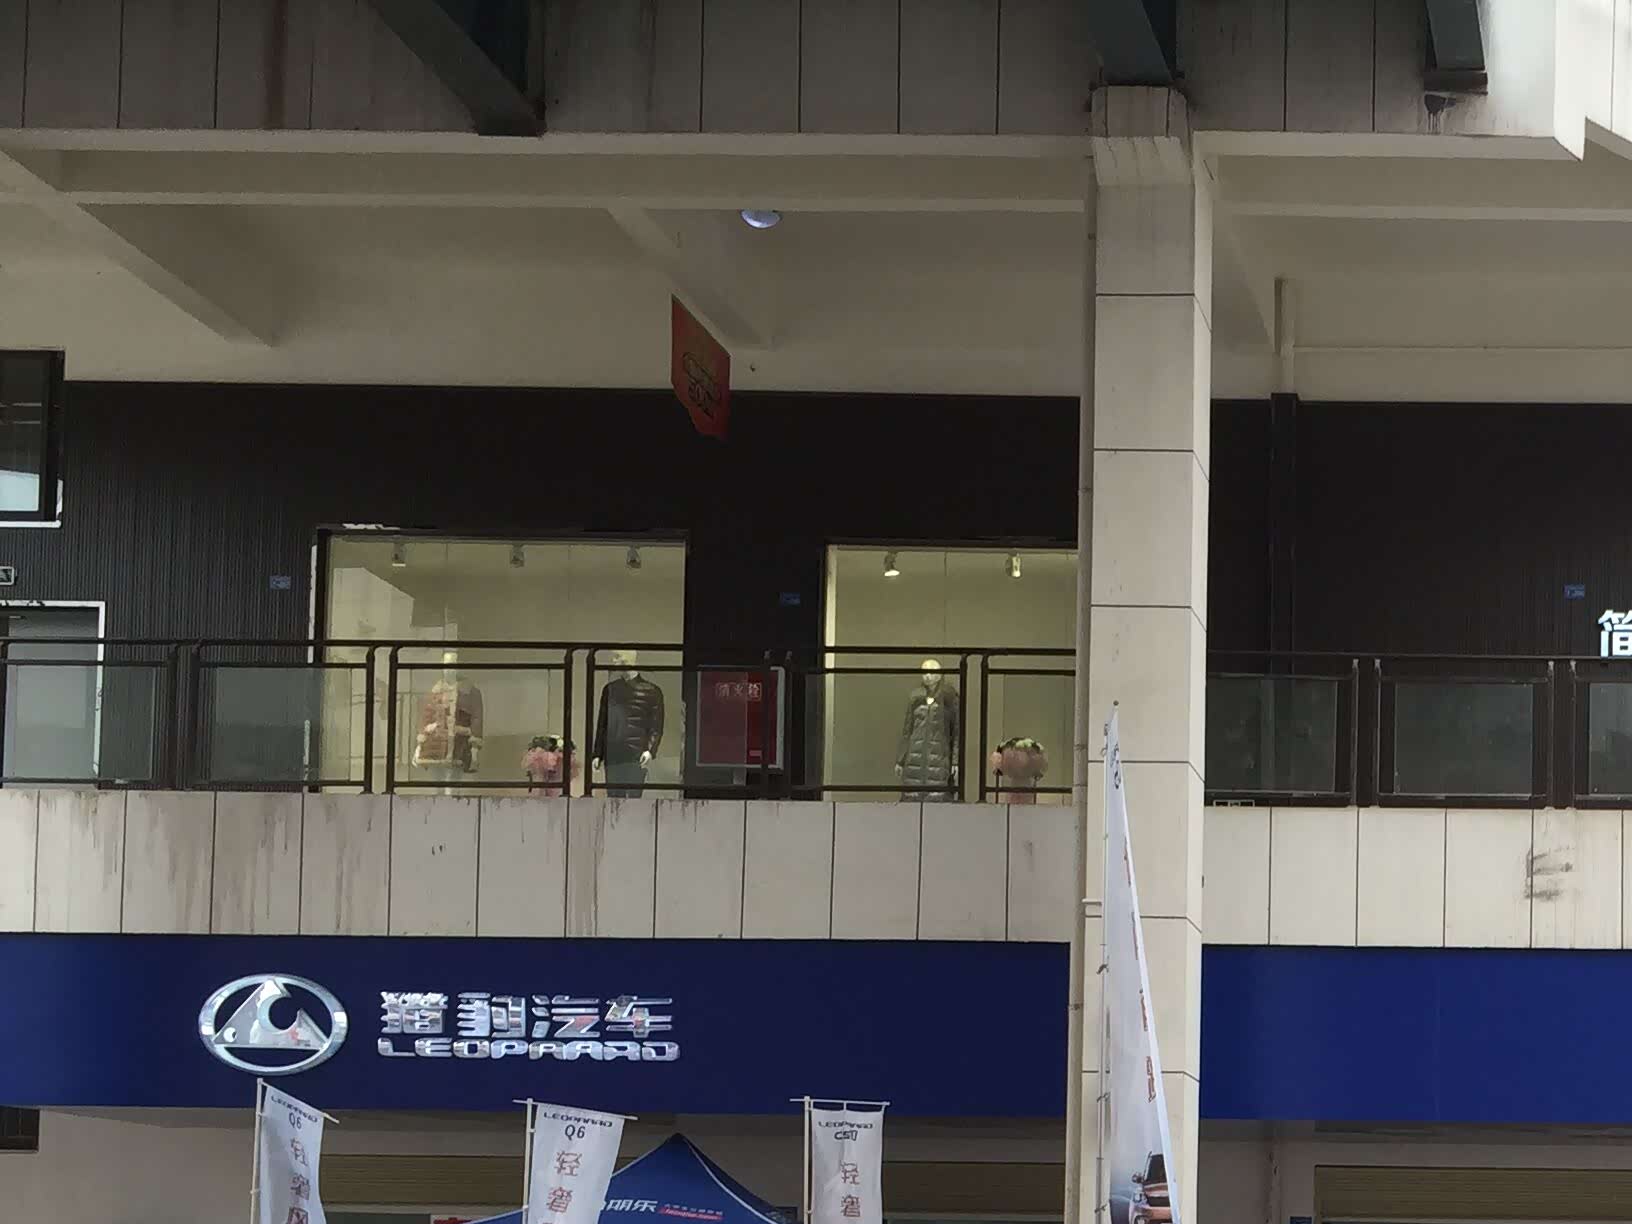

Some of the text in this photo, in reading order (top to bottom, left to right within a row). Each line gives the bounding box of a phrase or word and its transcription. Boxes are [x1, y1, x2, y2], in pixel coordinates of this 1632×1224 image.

[288, 1112, 303, 1130] Q6
[564, 1124, 586, 1141] Q6
[600, 1199, 658, 1213] 期乐
